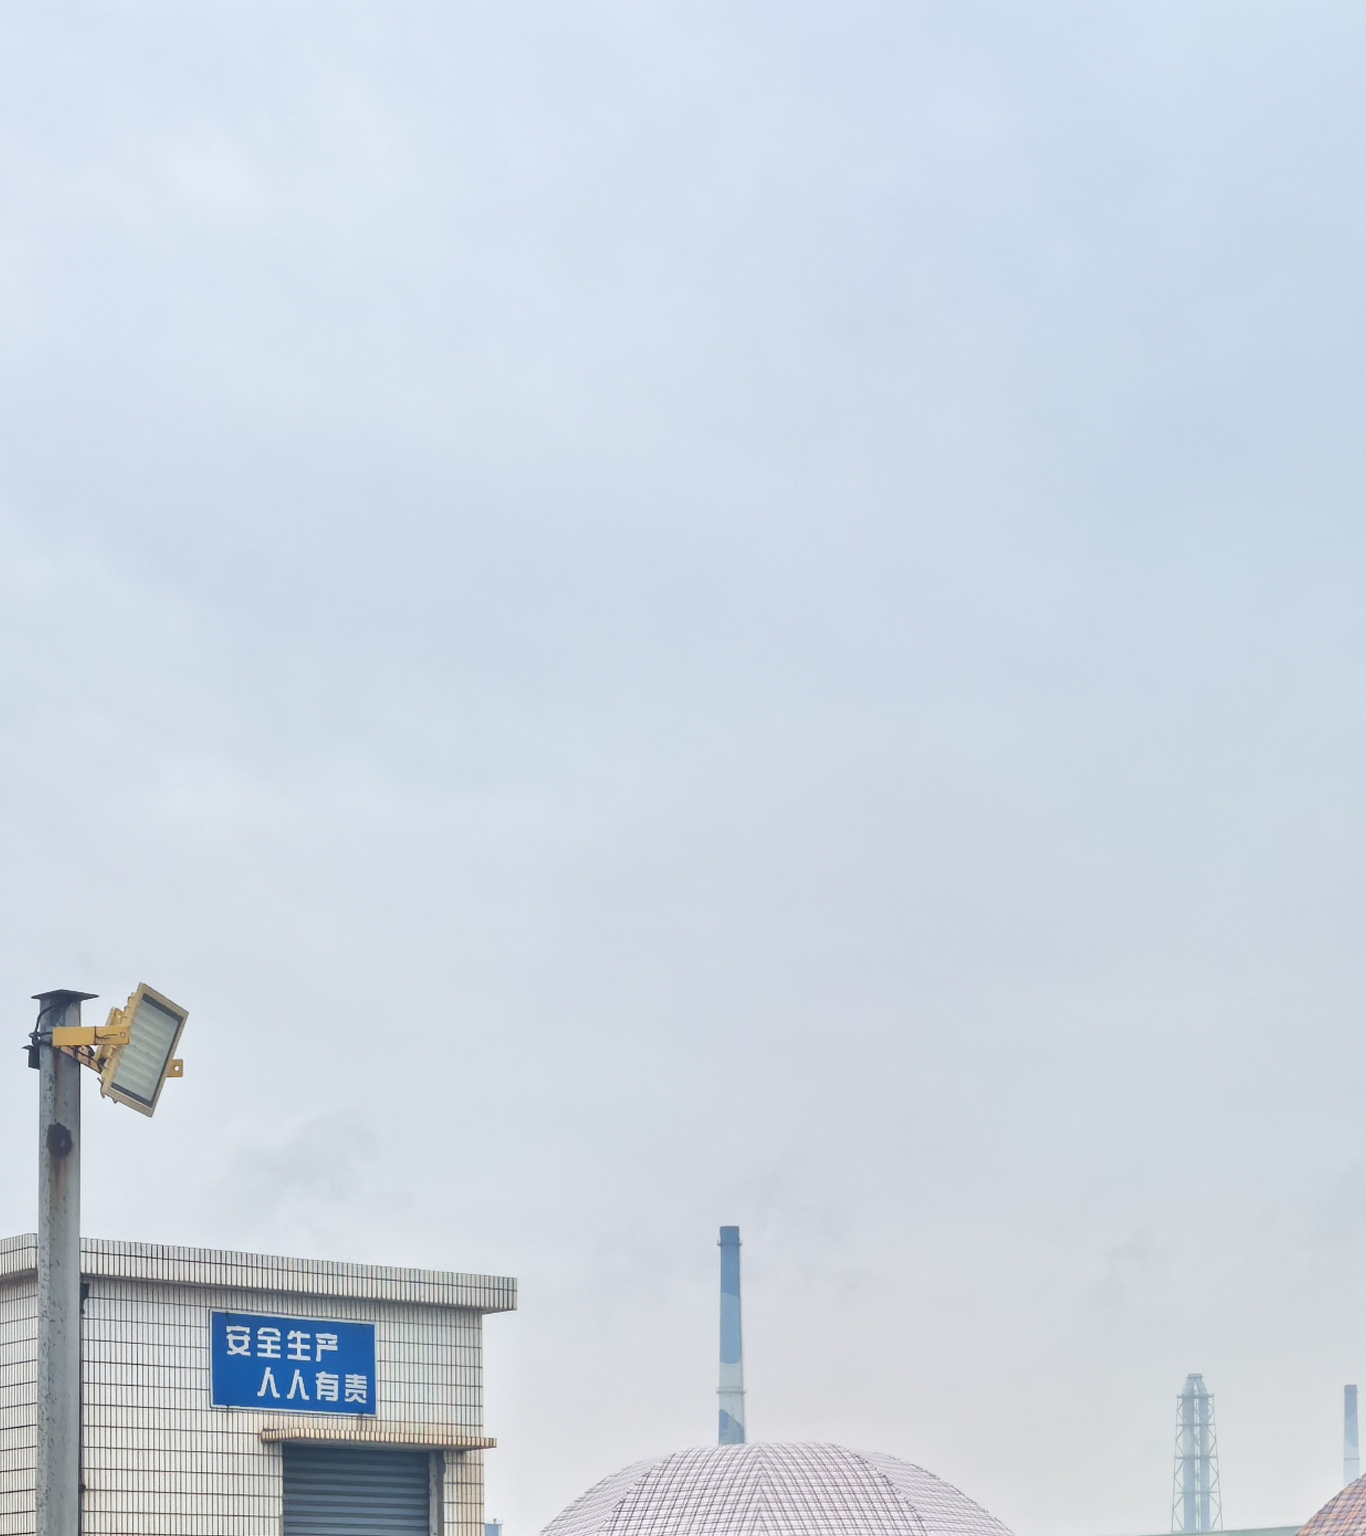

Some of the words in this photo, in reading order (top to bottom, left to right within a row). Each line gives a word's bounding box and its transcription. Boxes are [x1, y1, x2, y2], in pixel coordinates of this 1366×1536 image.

[225, 1325, 339, 1363] 安全生产
[256, 1366, 368, 1404] 人人有责
